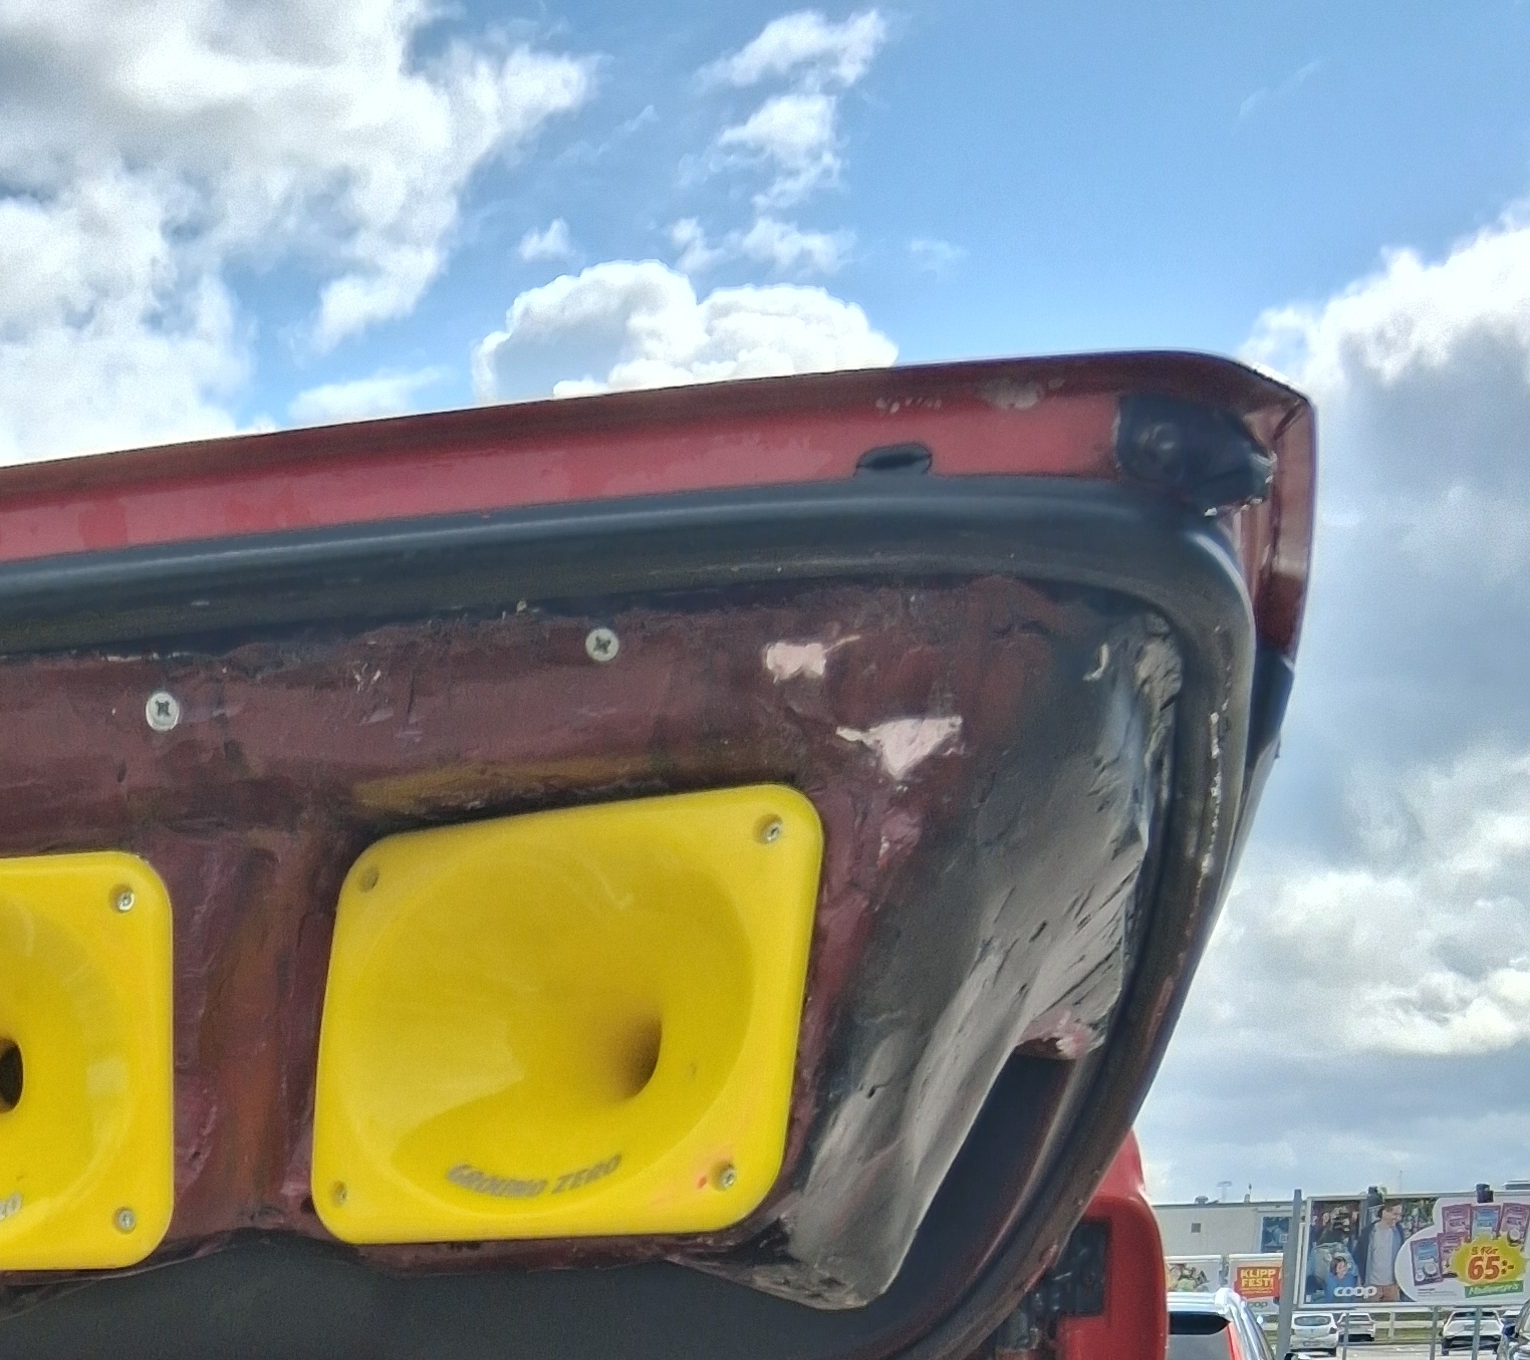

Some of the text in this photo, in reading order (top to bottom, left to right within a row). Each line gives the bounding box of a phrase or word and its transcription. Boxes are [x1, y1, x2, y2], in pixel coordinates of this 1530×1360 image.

[447, 1154, 622, 1198] GROUND ZERO
[1241, 1268, 1276, 1278] KLIPP
[1241, 1278, 1274, 1287] FEST!
[1333, 1286, 1377, 1299] coop
